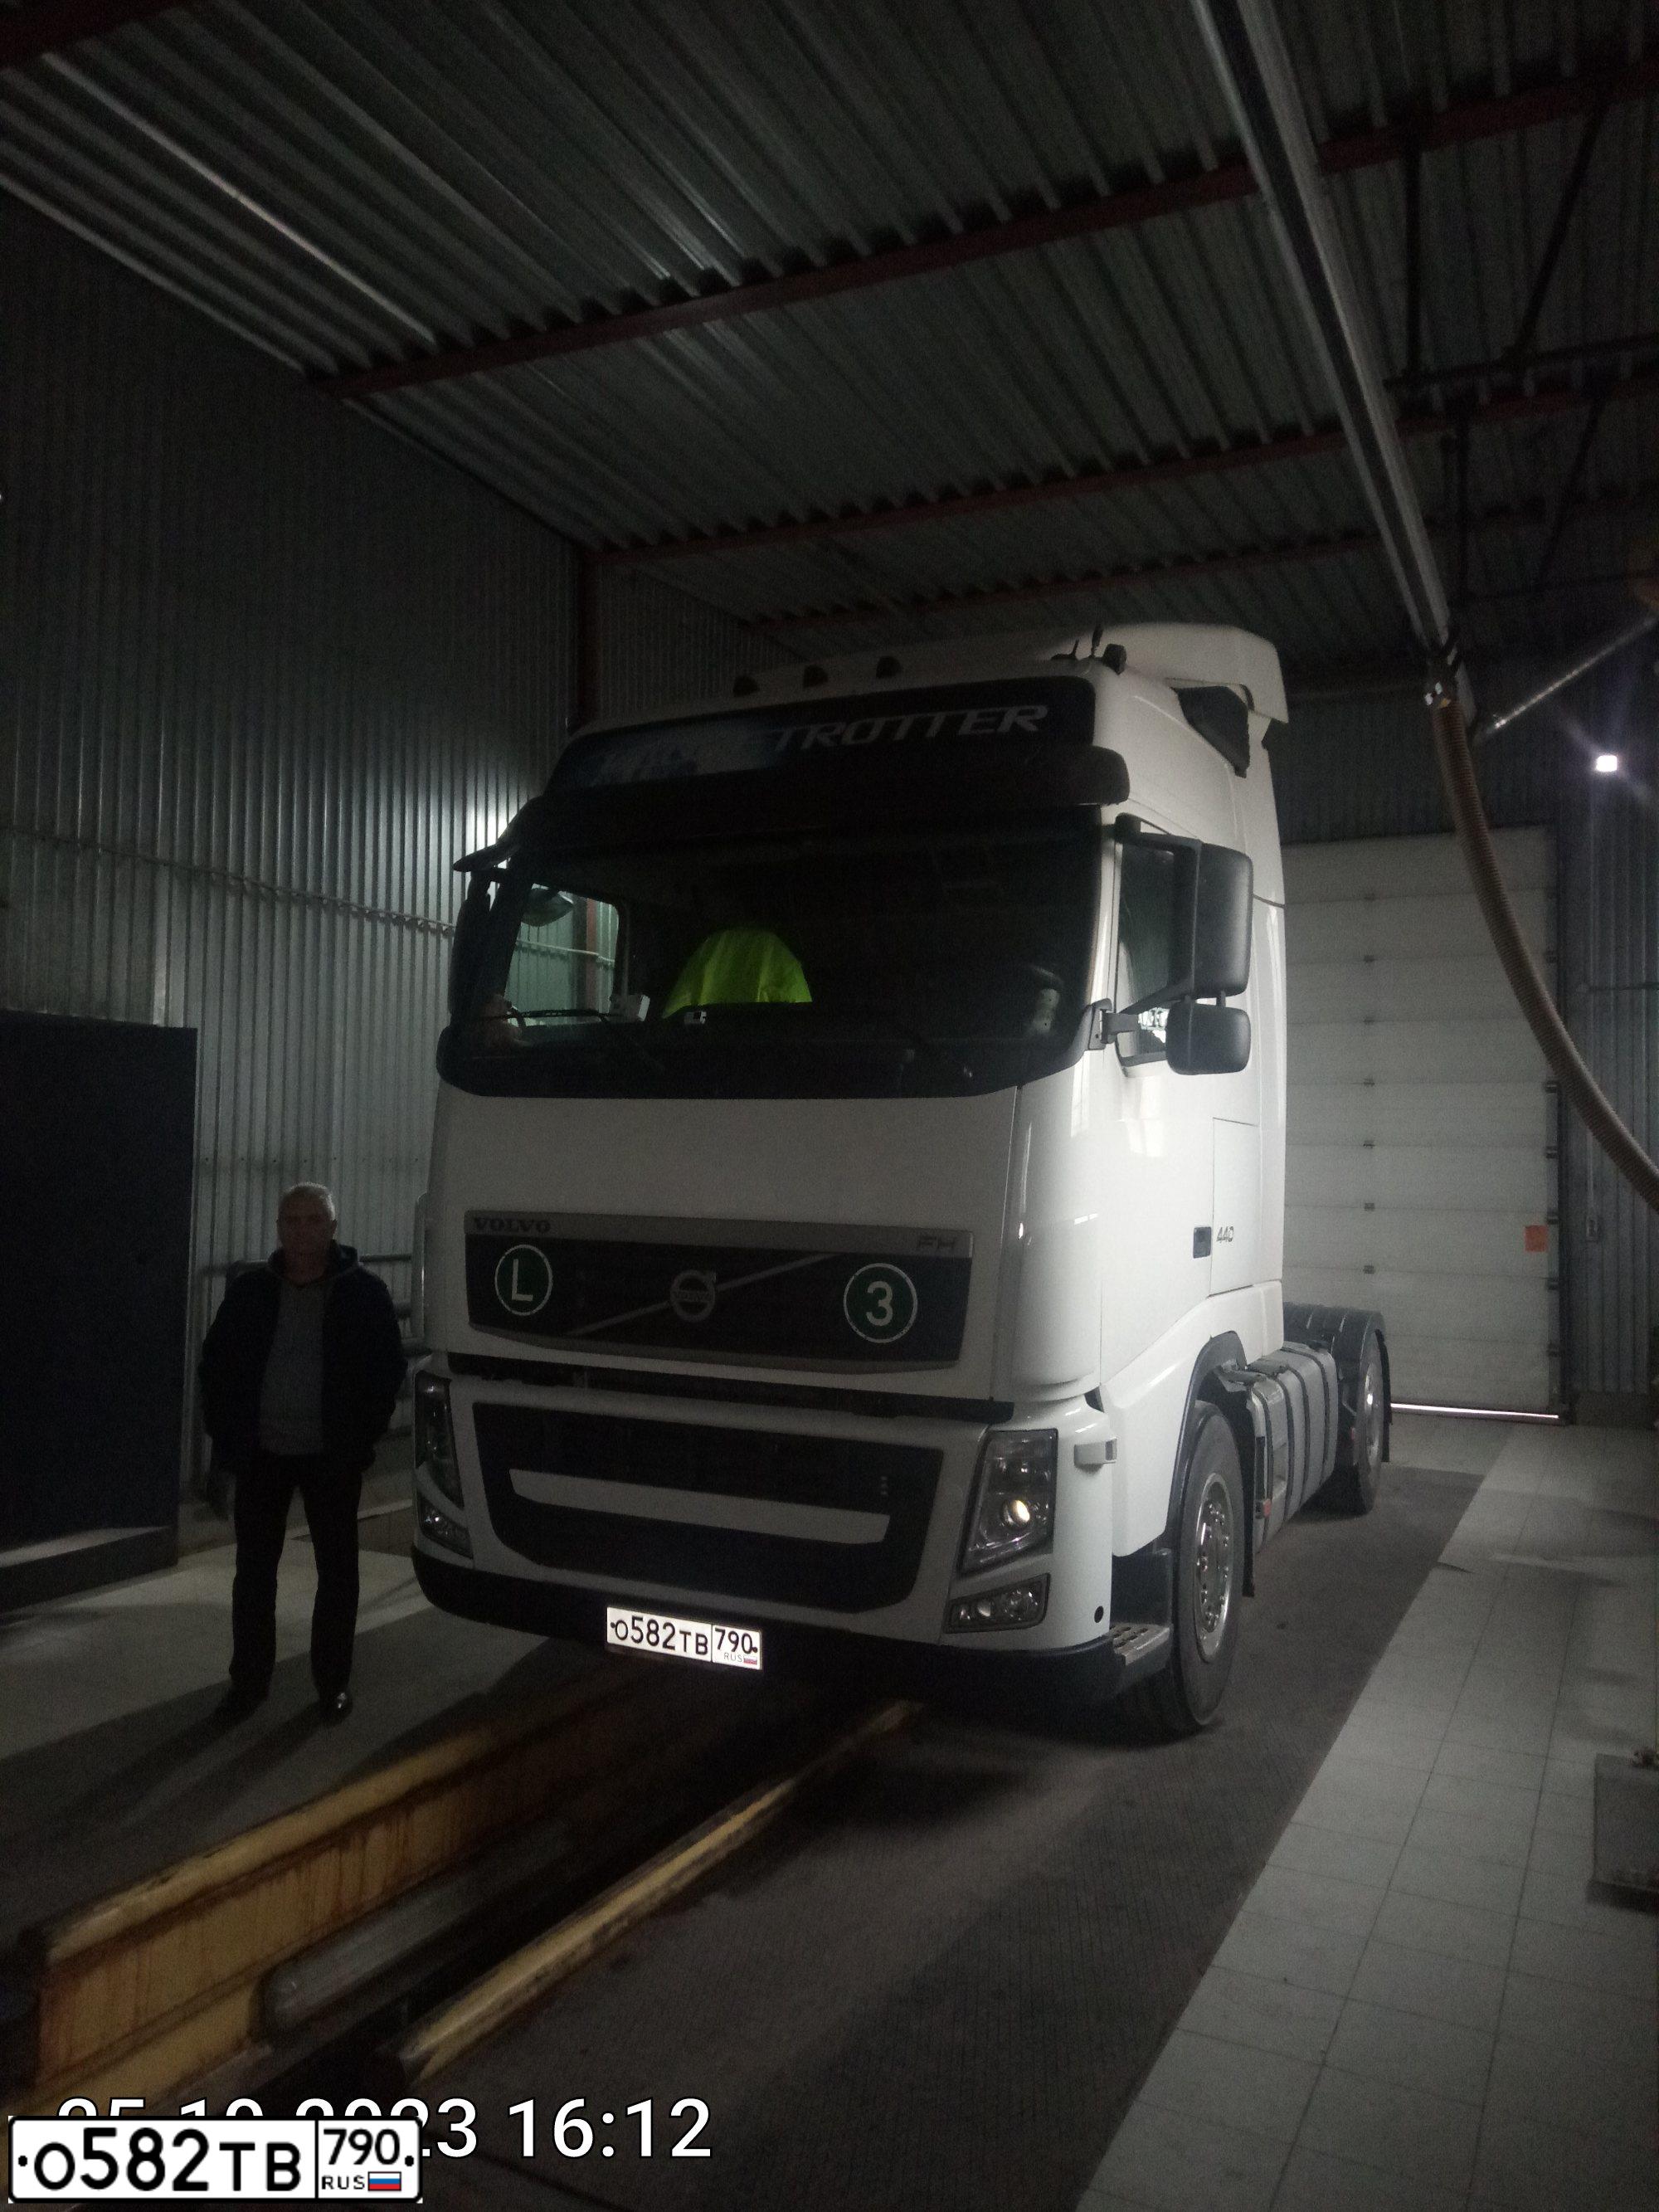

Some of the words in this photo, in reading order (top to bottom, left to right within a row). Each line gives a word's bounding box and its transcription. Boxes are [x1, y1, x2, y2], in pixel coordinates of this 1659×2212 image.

[474, 1217, 552, 1233] VOLVO
[1216, 1225, 1234, 1242] 440
[916, 1235, 958, 1253] FH
[510, 1258, 533, 1302] L
[866, 1280, 895, 1328] 3
[714, 1627, 754, 1654] 790
[723, 1652, 742, 1663] RUS
